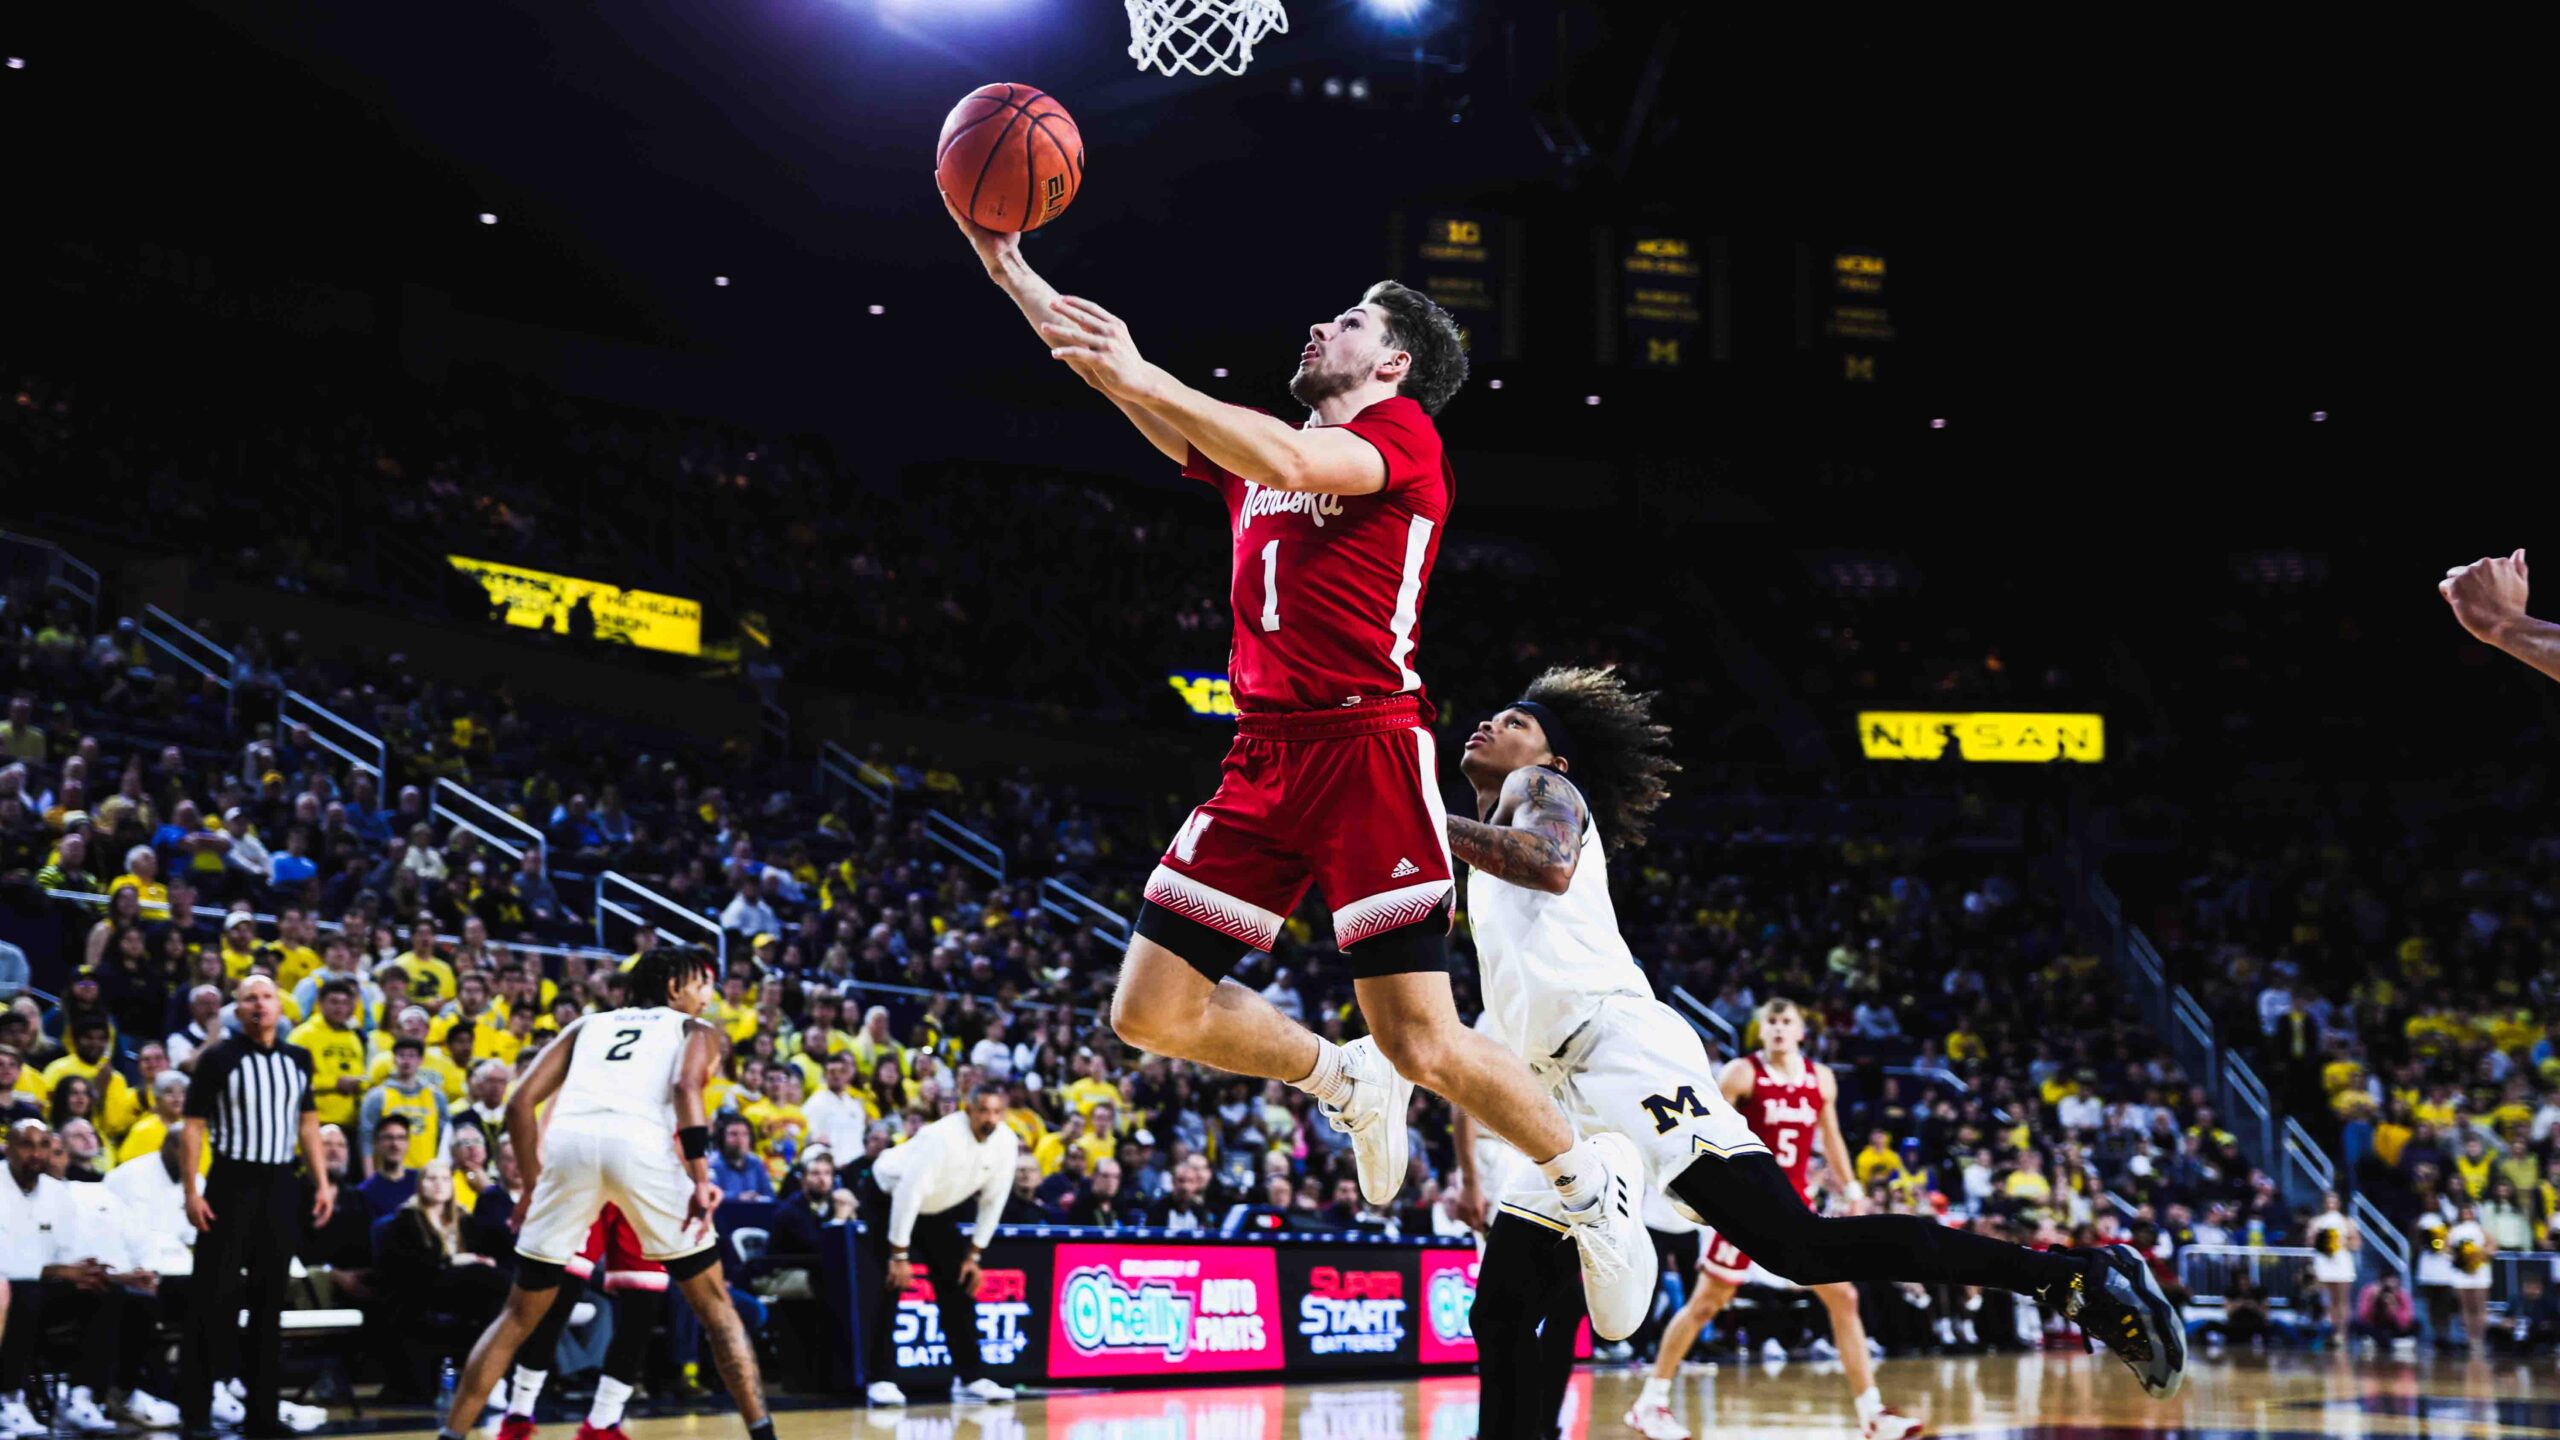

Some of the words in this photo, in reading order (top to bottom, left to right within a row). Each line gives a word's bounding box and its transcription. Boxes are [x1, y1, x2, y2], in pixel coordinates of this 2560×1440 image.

[1261, 540, 1280, 632] 1
[1391, 866, 1420, 879] adidas
[606, 1029, 642, 1061] 2
[1640, 1085, 1711, 1135] M
[1776, 1128, 1799, 1168] 5
[898, 1263, 1026, 1302] SER
[1201, 1279, 1257, 1314] AUTO
[1309, 1266, 1403, 1300] SUPER
[893, 1300, 1032, 1343] STRT
[1196, 1315, 1266, 1352] PARTS
[1299, 1295, 1408, 1335] START
